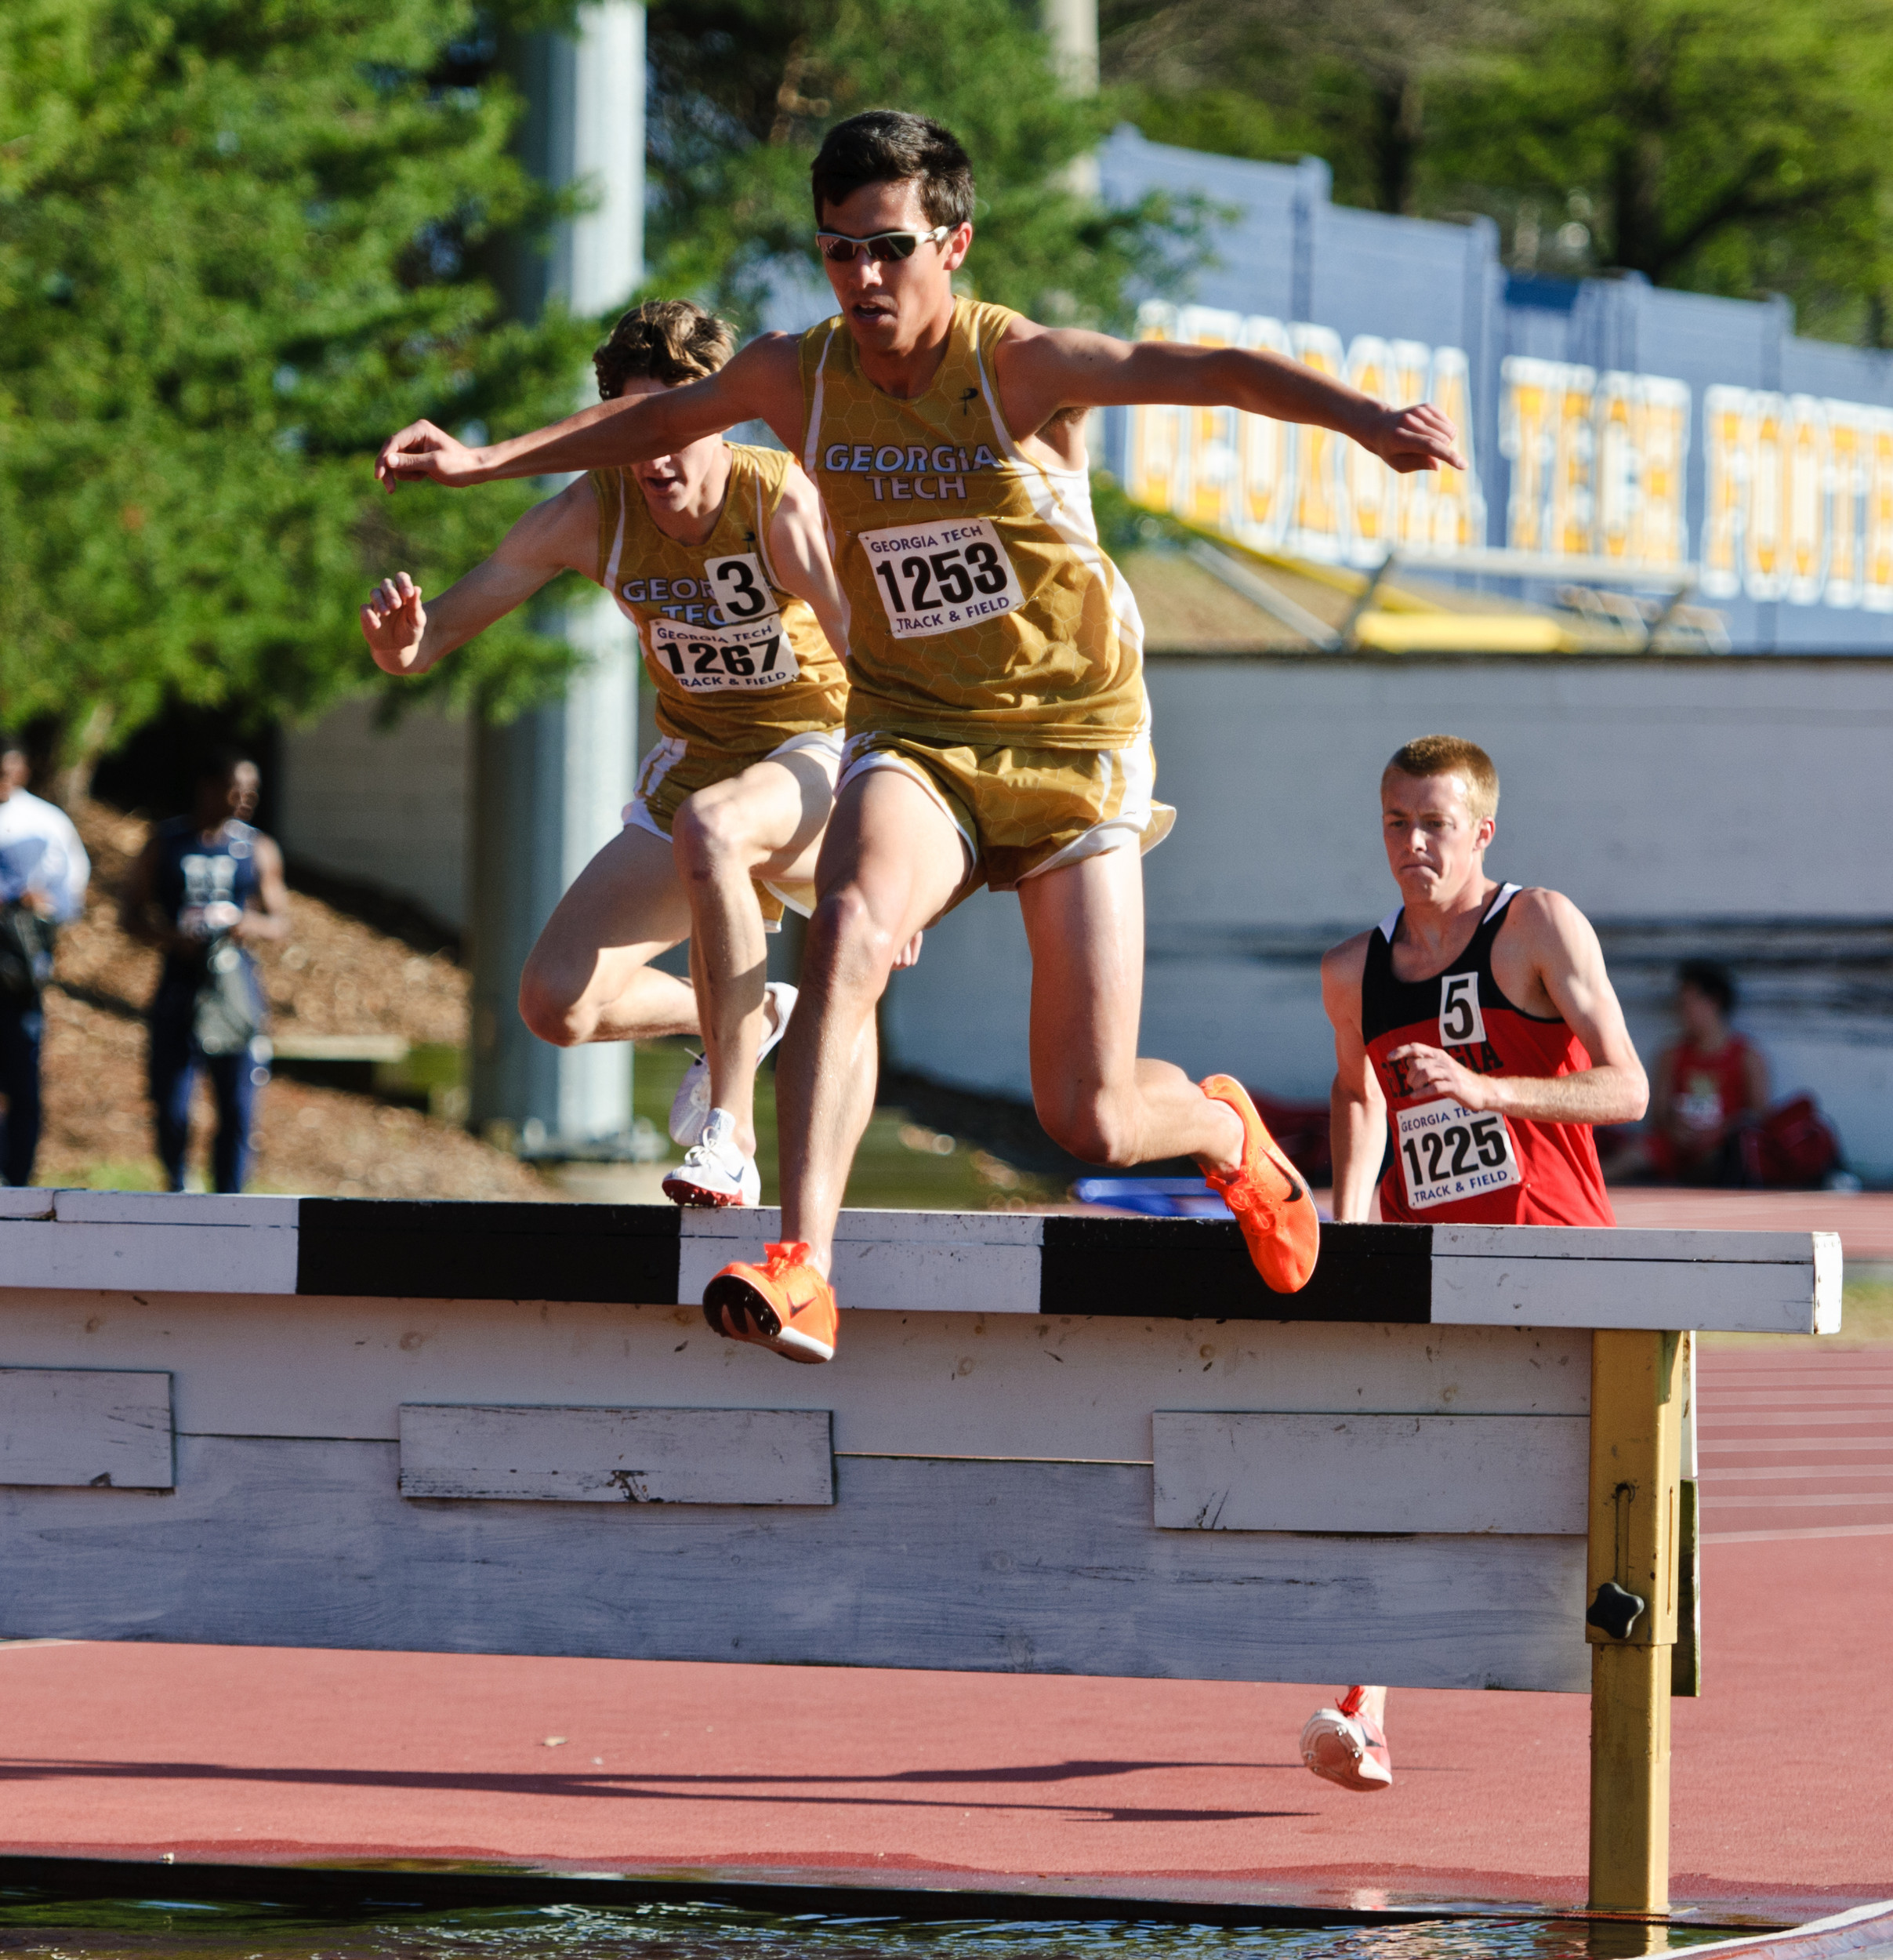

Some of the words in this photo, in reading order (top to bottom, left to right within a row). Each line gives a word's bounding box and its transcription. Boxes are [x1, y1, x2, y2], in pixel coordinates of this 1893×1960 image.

[825, 443, 1004, 473] GEORGIA
[865, 475, 967, 501] TECH
[870, 535, 938, 554] GEORGIA
[941, 525, 983, 543] TECH
[622, 577, 772, 602] GEOR
[716, 561, 766, 617] 3
[876, 542, 1008, 613] 1253
[661, 603, 740, 626] TEC
[897, 613, 944, 630] TRACK
[948, 611, 961, 622] &
[966, 597, 1010, 619] FIELD
[657, 627, 728, 644] GEORGIA
[733, 625, 772, 642] TECH
[657, 634, 780, 677] 1267
[676, 677, 723, 688] RACK
[745, 671, 786, 686] FIELD
[1443, 978, 1474, 1040] 5
[1402, 1113, 1451, 1132] GEORGIA
[1403, 1116, 1507, 1186] 1225
[1414, 1185, 1450, 1203] TRACK
[1456, 1181, 1464, 1192] &
[1470, 1170, 1507, 1189] FIELD
